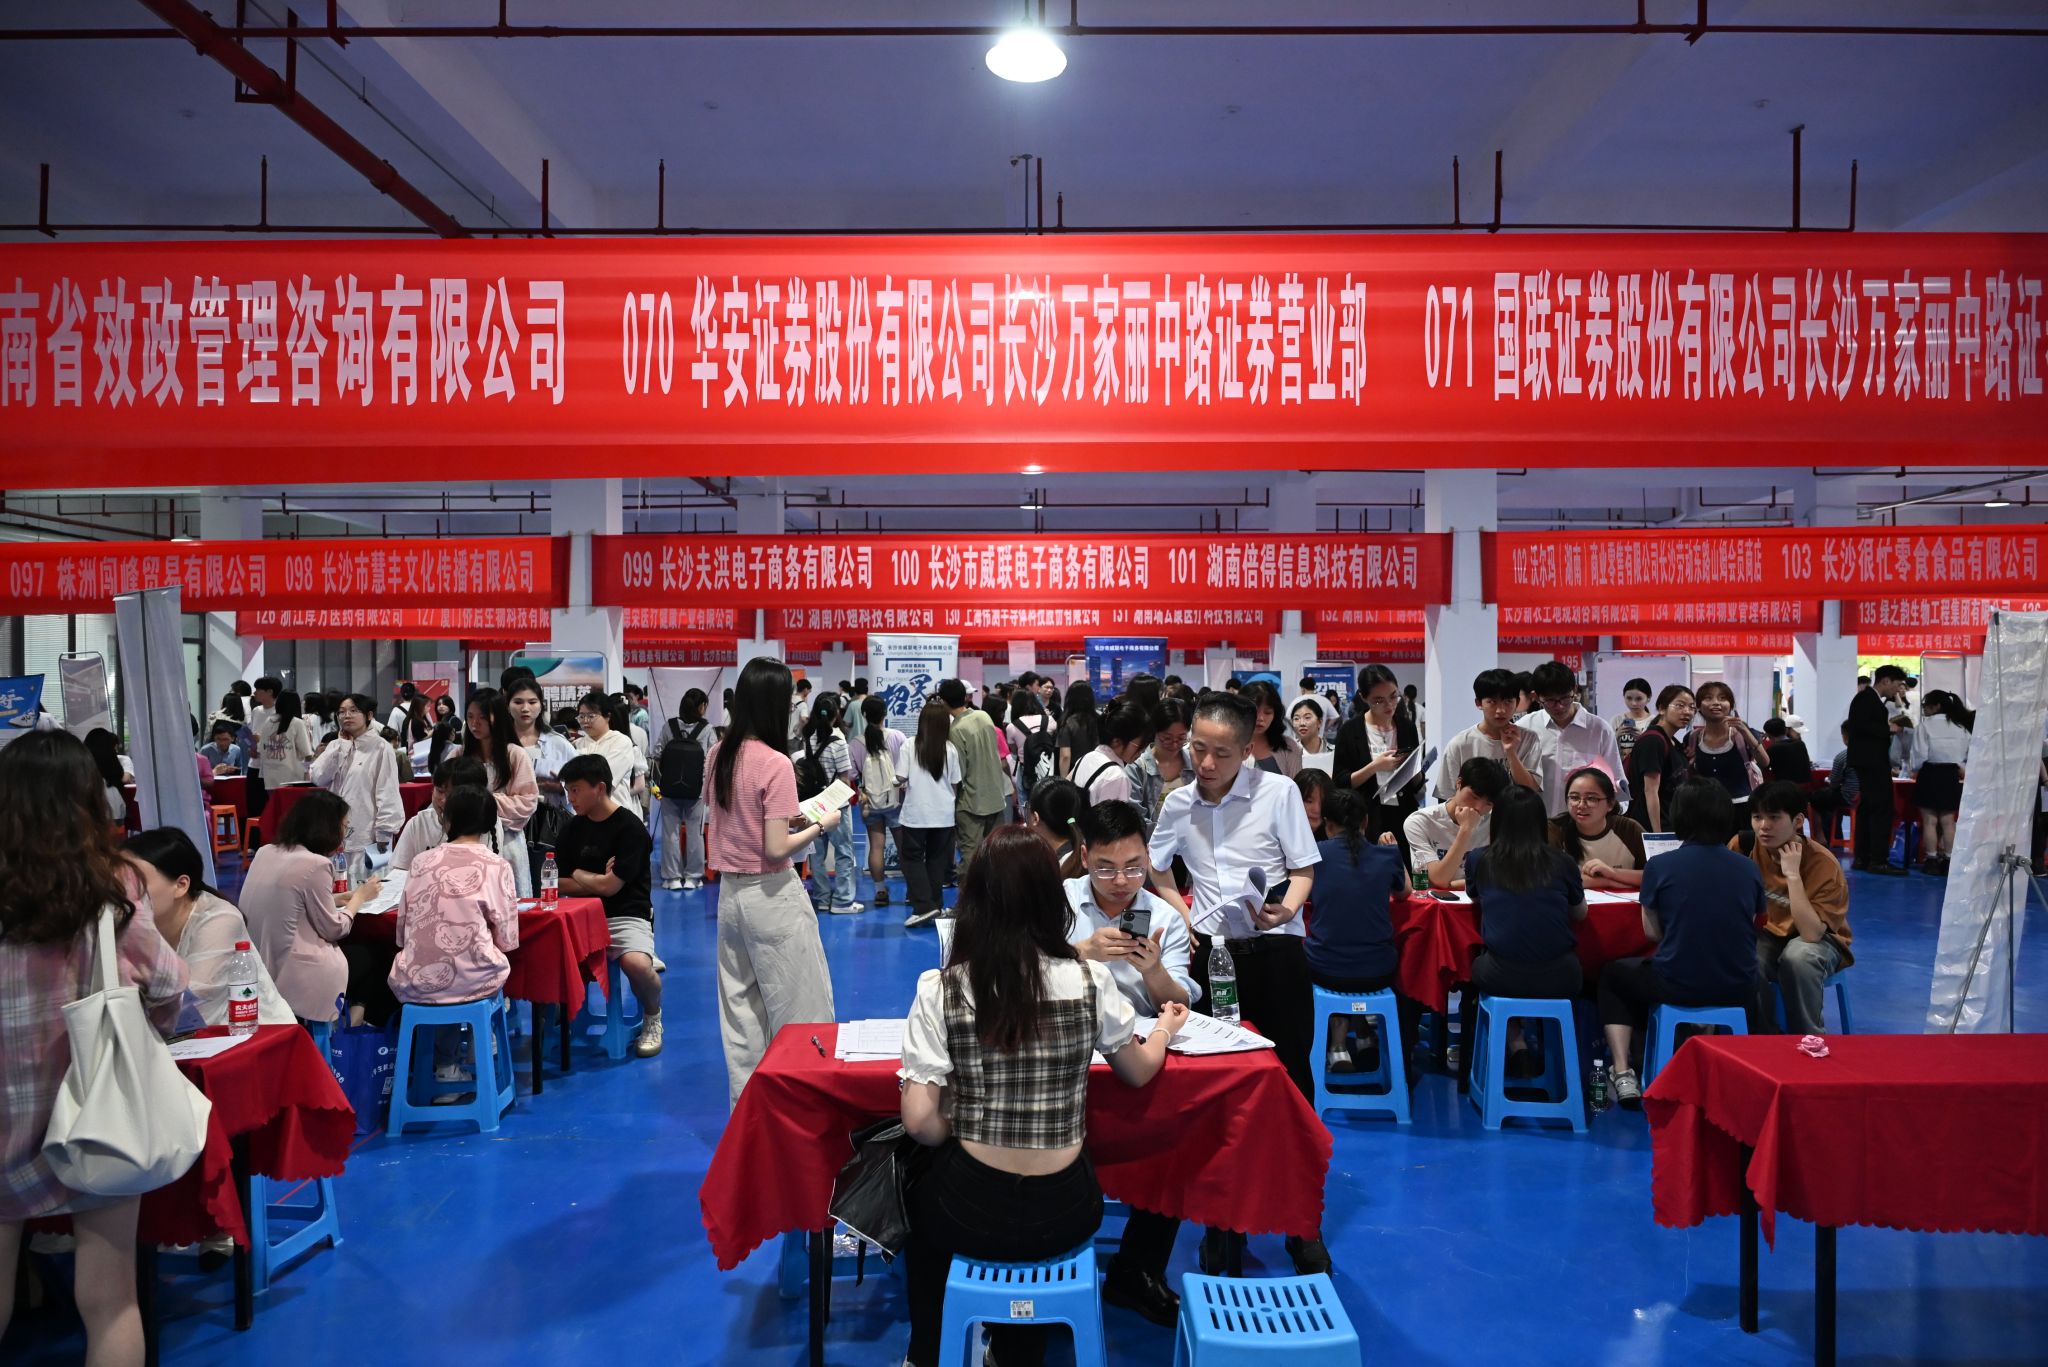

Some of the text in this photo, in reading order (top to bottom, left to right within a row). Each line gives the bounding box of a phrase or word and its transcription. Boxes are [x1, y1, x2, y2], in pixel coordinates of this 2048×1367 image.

[0, 268, 2047, 408] 南省效政管理咨询有限公司 070 华安证券股份有限公司长沙万家丽中路证券营业部 071 国联证券股份有限公司长沙万家丽中路证
[11, 562, 44, 597] 097
[286, 556, 313, 591] 098
[322, 549, 533, 594] 长沙市慧丰文化传播有限公司
[623, 543, 1416, 590] 099 长沙夫洪电子商务有限公司 100 长沙市威联电子商务有限公司 101 湖南倍得信息科技有限公司
[1513, 549, 1528, 583] 102
[1782, 544, 1811, 579] 103
[1822, 536, 2037, 582] 长沙很忙零食食品有限公司
[783, 609, 803, 627] 129
[1860, 602, 1876, 623] 135
[1561, 656, 1579, 668] 195
